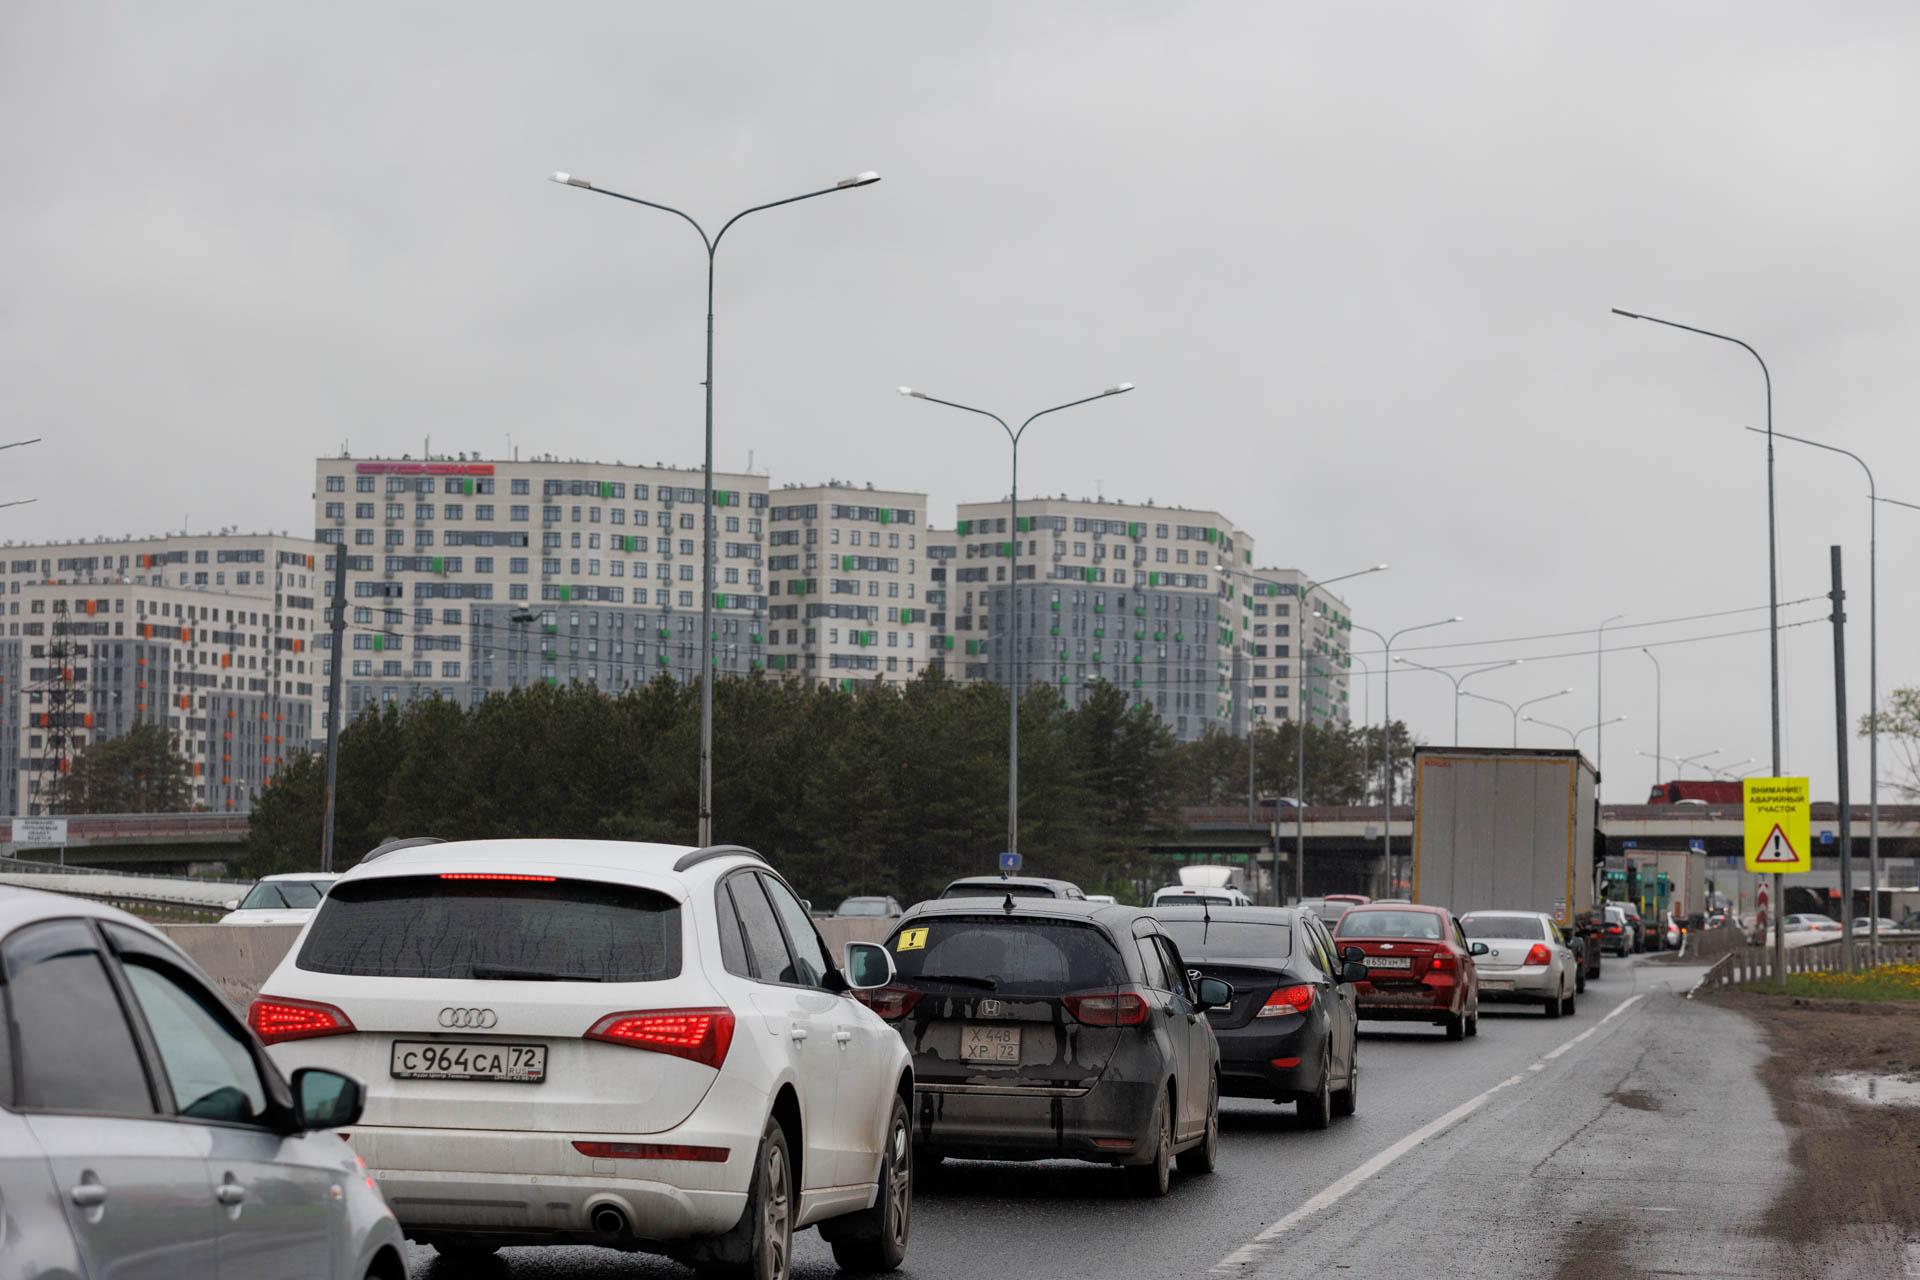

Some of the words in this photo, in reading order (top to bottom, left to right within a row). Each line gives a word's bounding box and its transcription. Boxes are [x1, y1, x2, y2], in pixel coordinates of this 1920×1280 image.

[1751, 786, 1802, 794] ВНИМАНИЕ!
[985, 1029, 1011, 1042] 448
[1000, 1045, 1014, 1057] 72
[403, 1047, 503, 1073] С964СА
[511, 1048, 536, 1067] 72
[508, 1067, 527, 1075] RUS
